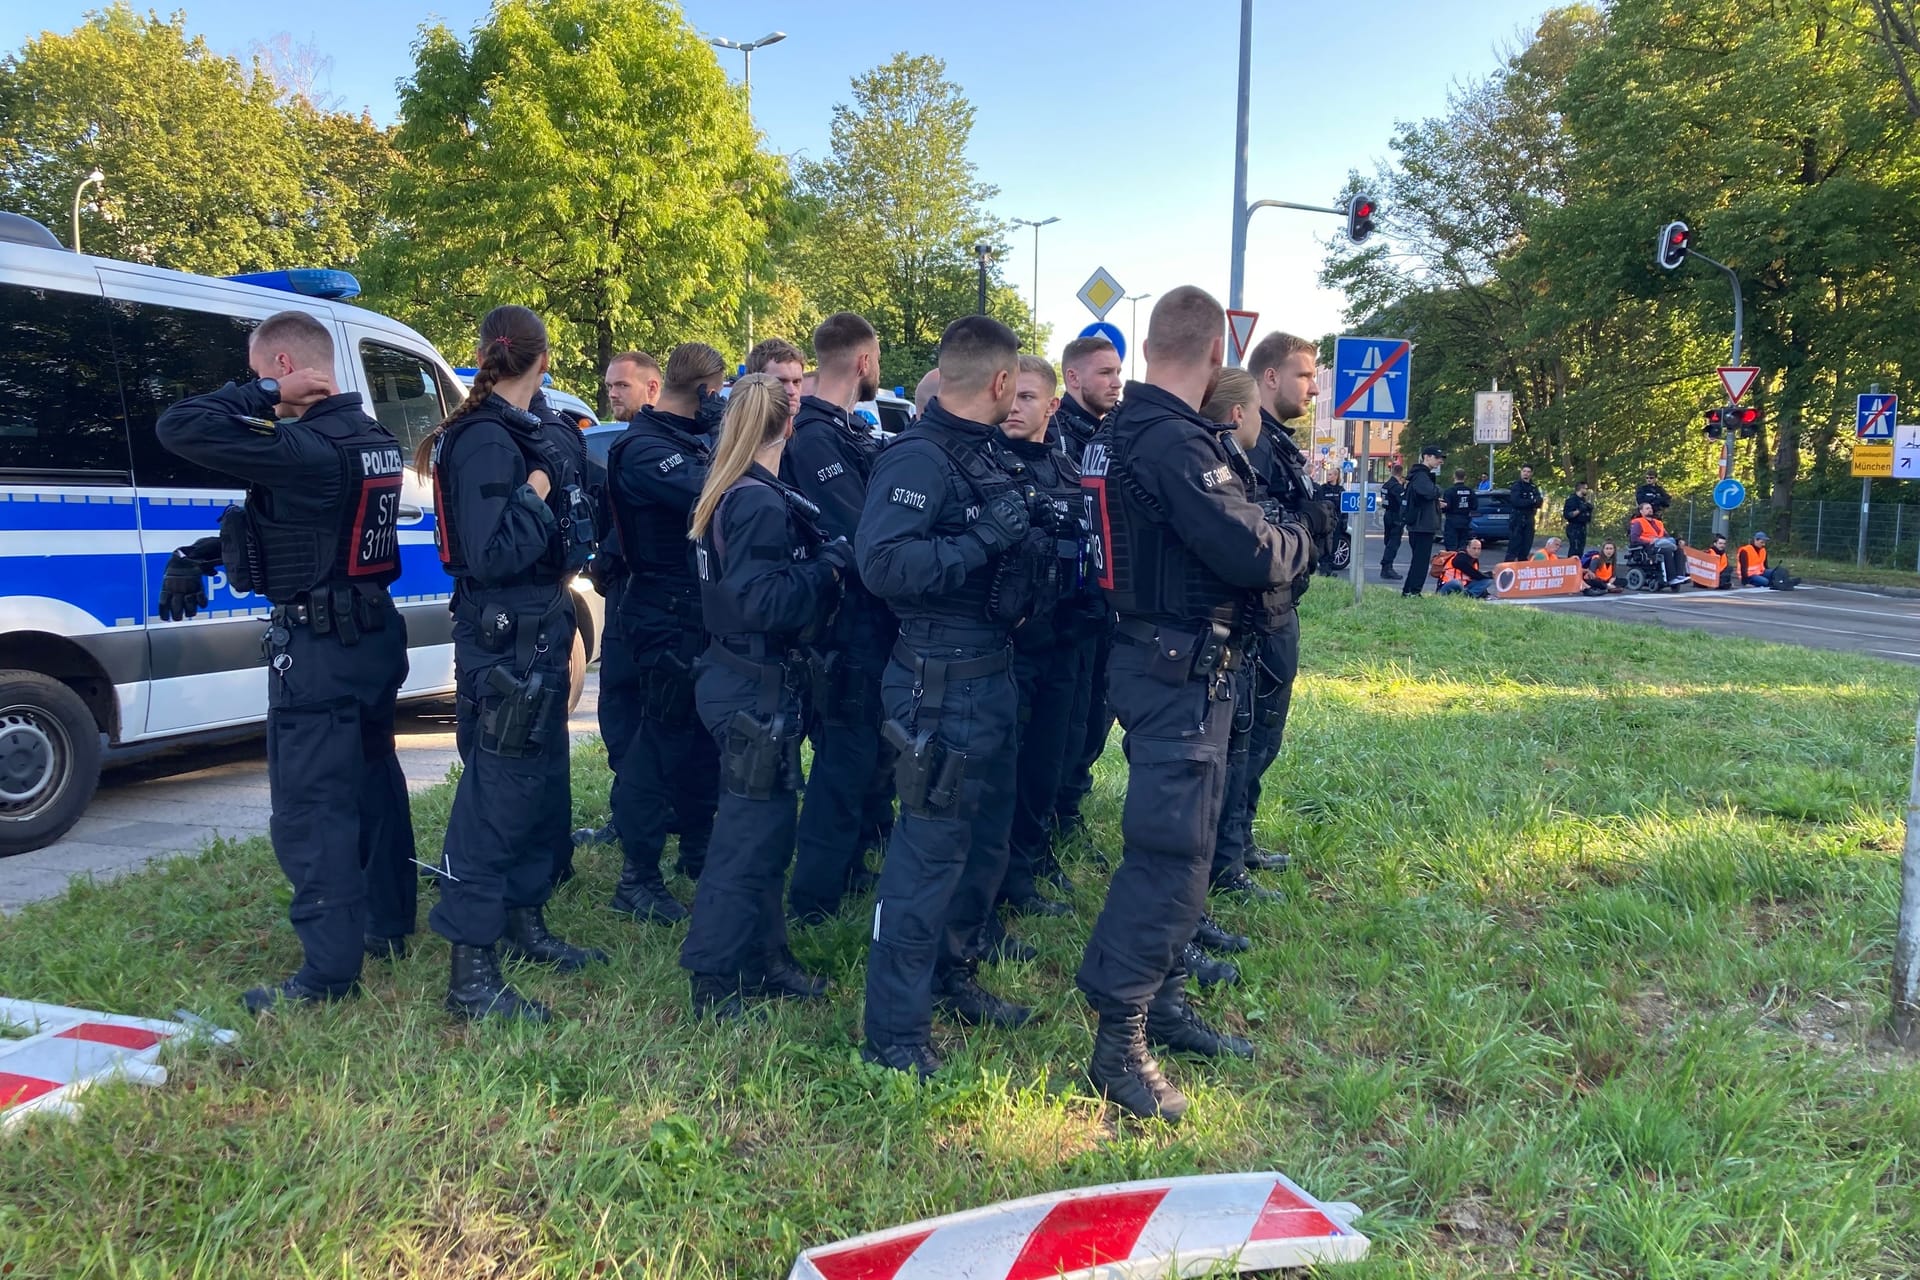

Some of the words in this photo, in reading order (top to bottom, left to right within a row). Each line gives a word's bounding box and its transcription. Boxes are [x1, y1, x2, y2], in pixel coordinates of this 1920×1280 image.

[660, 461, 671, 472] ST
[1854, 461, 1891, 471] München
[817, 469, 828, 482] ST
[1203, 471, 1216, 488] ST
[893, 488, 906, 502] ST
[904, 490, 926, 509] 31112
[378, 493, 396, 525] ST
